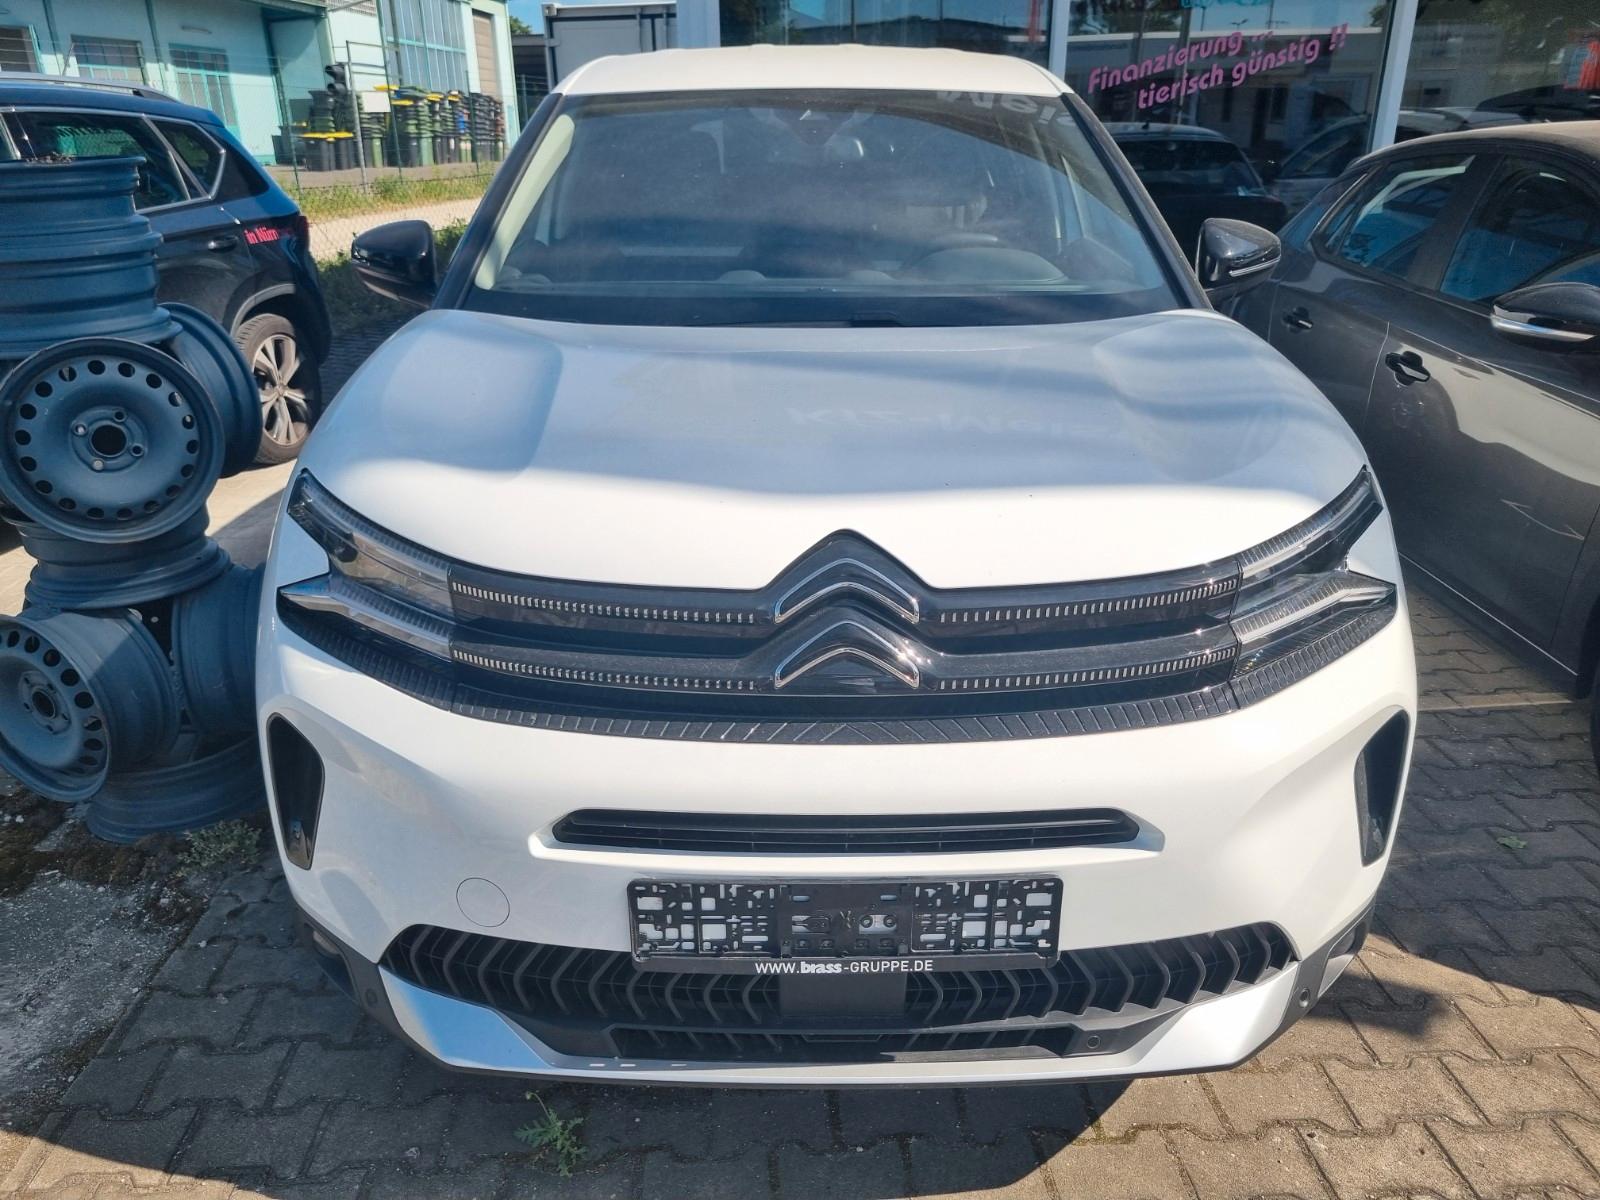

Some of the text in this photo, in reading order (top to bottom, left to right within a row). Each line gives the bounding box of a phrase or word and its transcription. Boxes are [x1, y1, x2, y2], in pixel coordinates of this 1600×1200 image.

[1088, 31, 1243, 93] Finanzierung
[1138, 64, 1224, 109] tierisch
[1232, 38, 1320, 87] günstig
